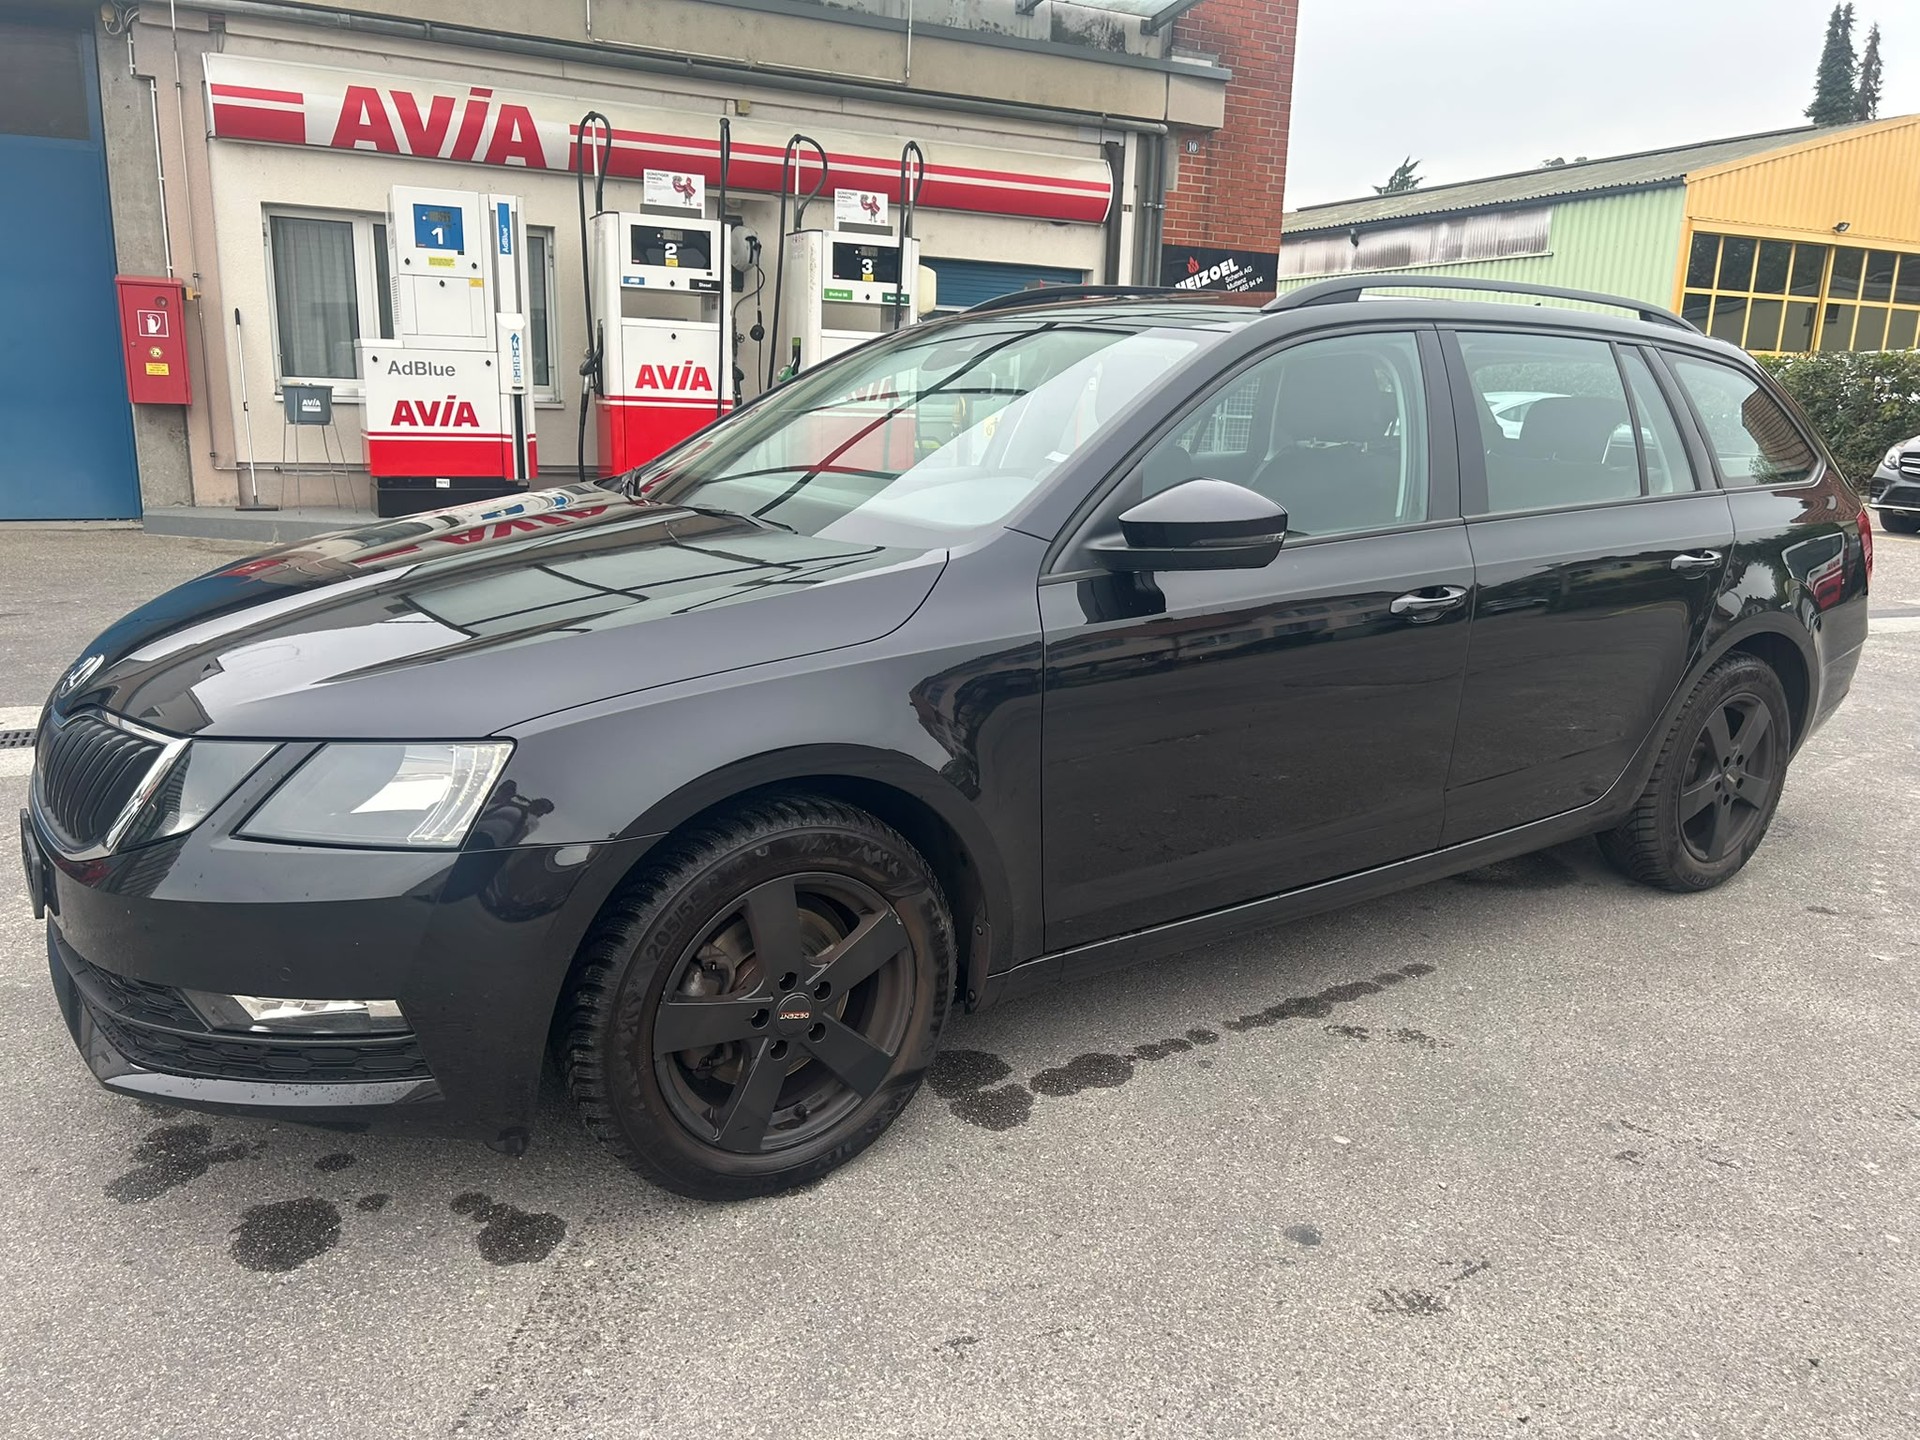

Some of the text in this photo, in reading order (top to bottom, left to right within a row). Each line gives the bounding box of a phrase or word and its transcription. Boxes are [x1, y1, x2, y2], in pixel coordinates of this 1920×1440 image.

[330, 84, 547, 168] AVIA
[1188, 141, 1198, 152] 10
[430, 227, 444, 245] 1
[664, 242, 678, 259] 2
[861, 258, 874, 275] 3
[1174, 257, 1239, 290] HEIZOEL
[1243, 265, 1253, 275] AG
[387, 360, 456, 377] AdBlue
[635, 360, 713, 391] AVIA
[390, 395, 480, 428] AVIA
[779, 1011, 811, 1021] DEZENT
